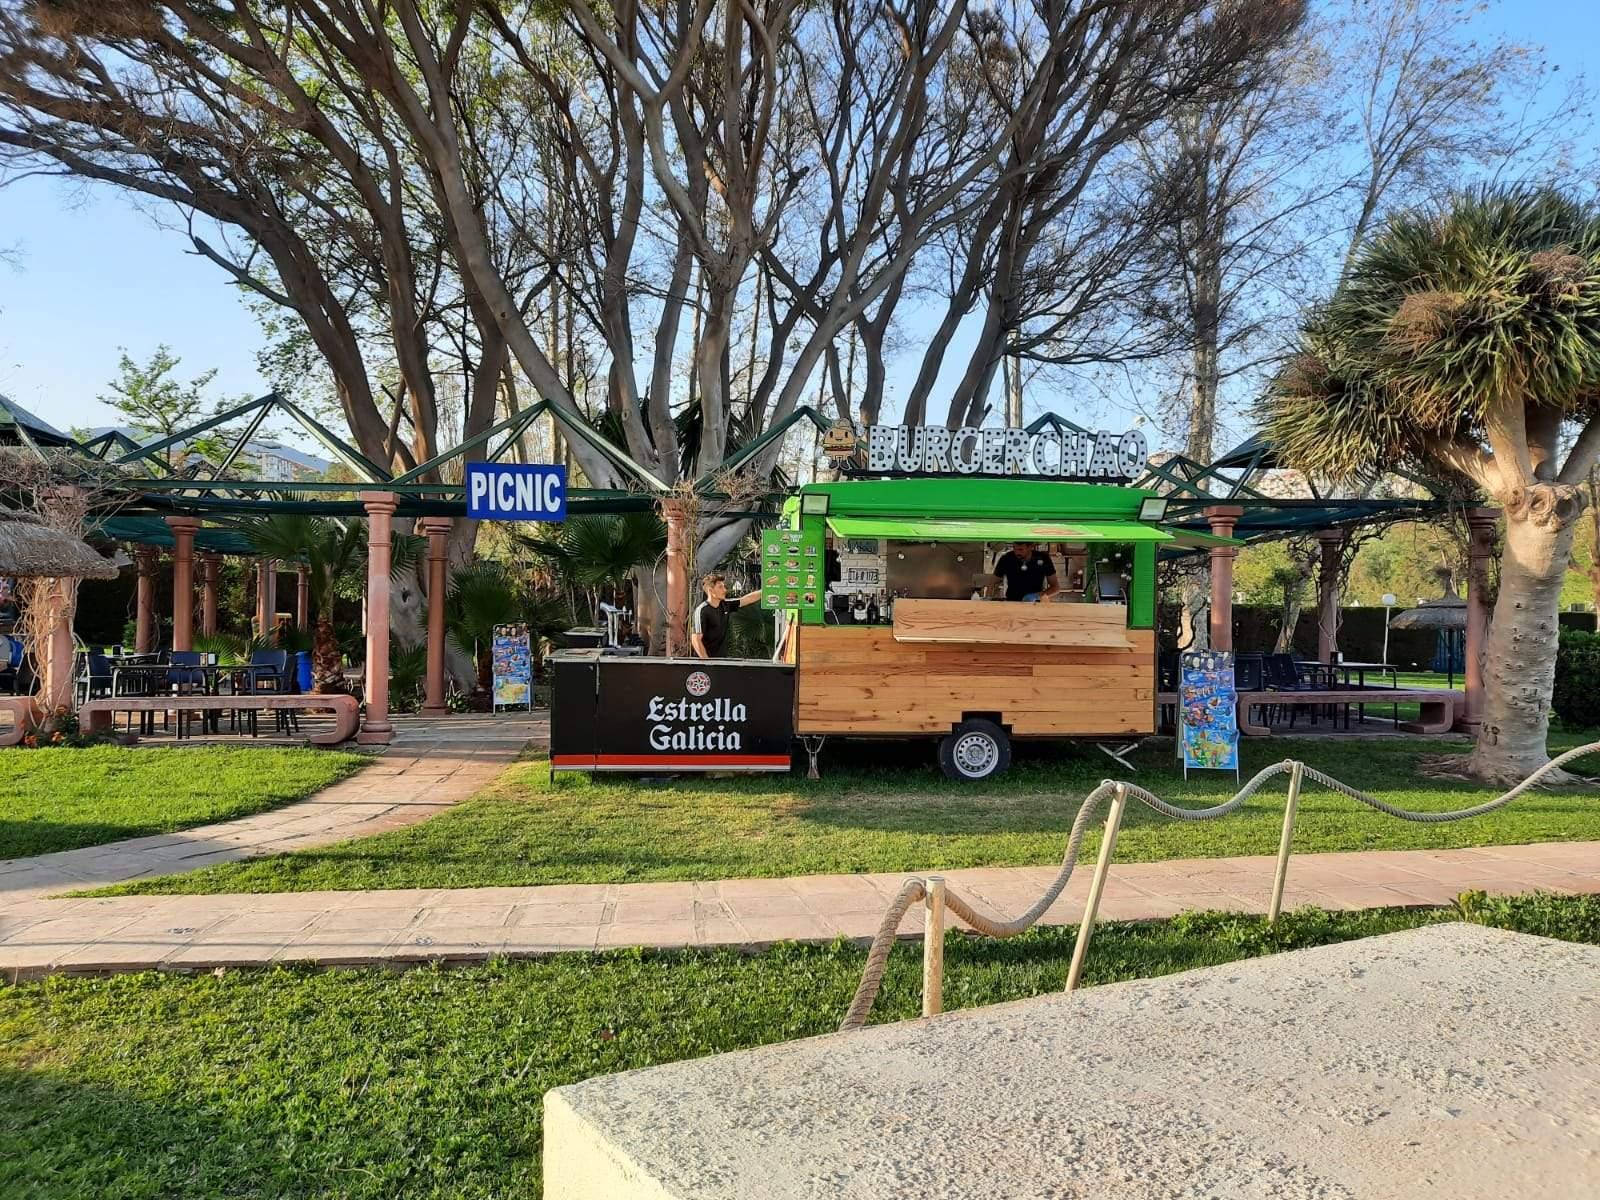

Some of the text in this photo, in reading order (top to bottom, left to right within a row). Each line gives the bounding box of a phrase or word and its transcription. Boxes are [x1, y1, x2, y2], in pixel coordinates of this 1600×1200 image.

[471, 472, 561, 512] PICNIC
[646, 695, 747, 722] Estrella
[649, 724, 742, 750] Galicia
